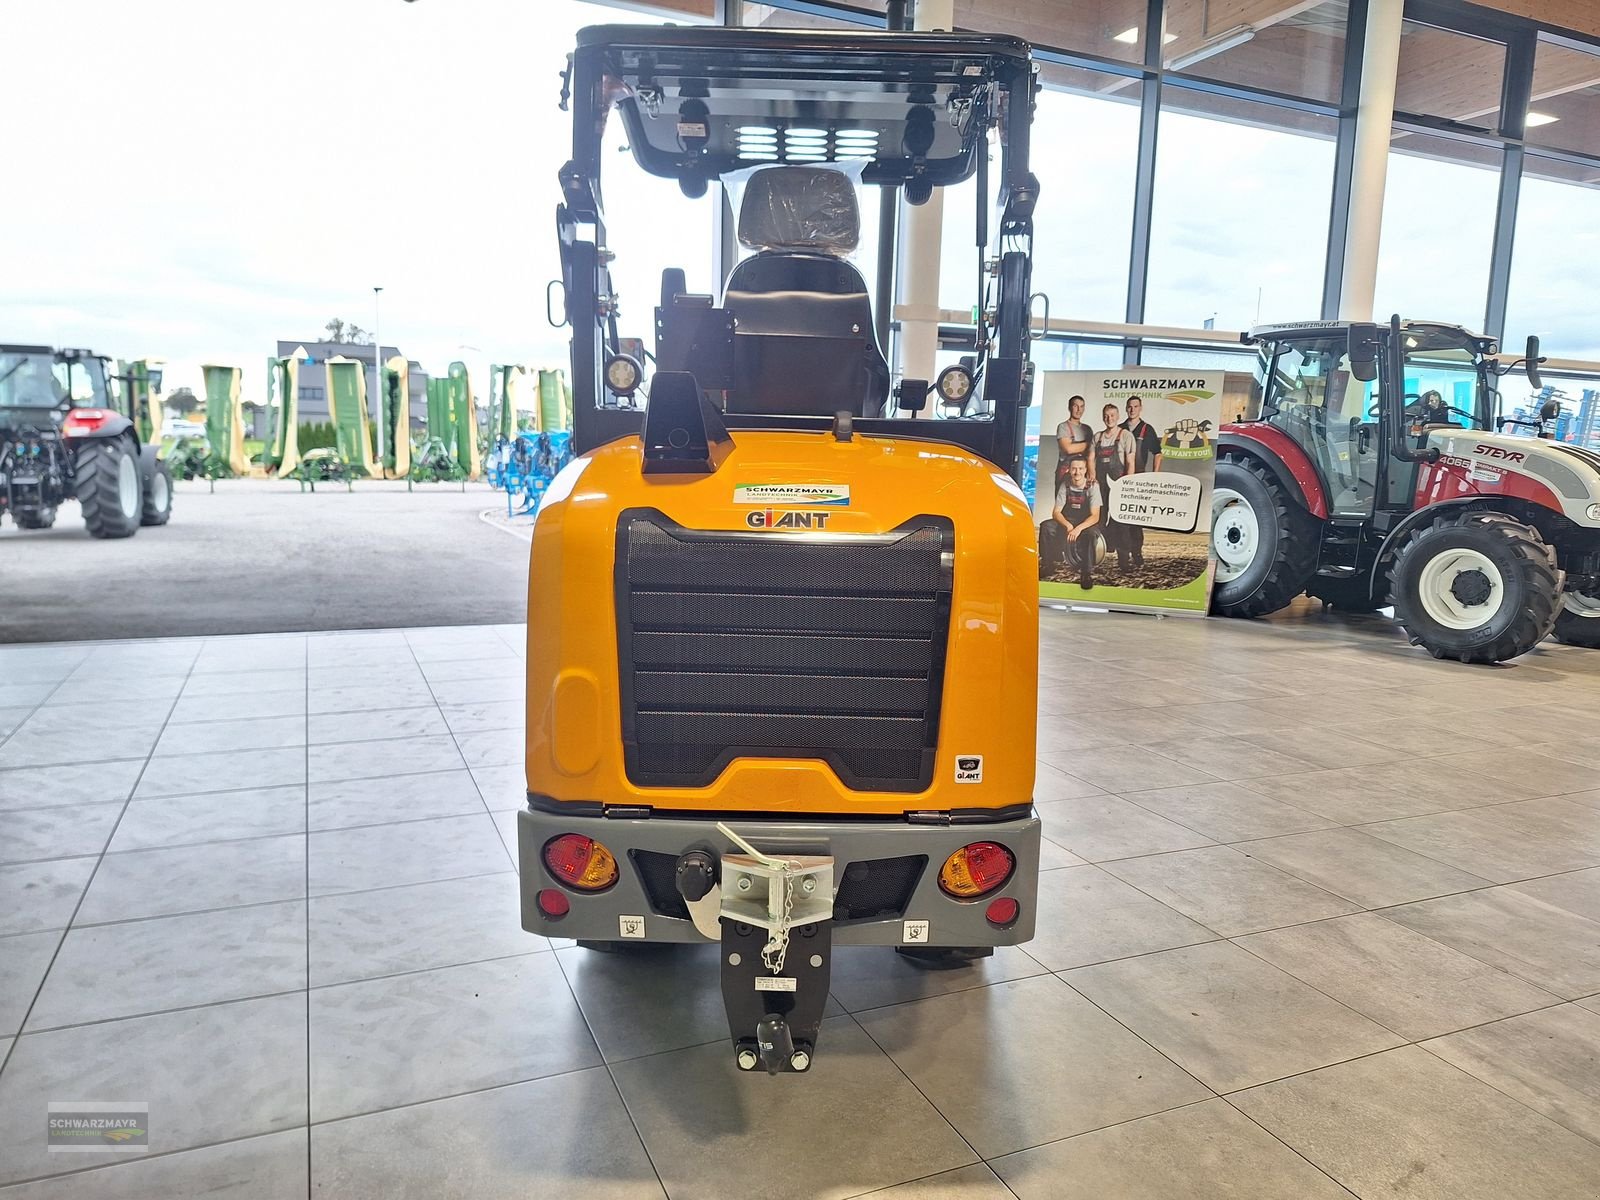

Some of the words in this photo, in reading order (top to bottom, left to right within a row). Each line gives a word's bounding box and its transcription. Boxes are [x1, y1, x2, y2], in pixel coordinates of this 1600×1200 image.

[1103, 379, 1206, 390] SCHWARZMAYR
[1103, 391, 1163, 399] LANDTECHNIK
[1171, 449, 1193, 457] WANT
[1473, 444, 1525, 463] STEYR
[1440, 456, 1470, 469] 4065
[1160, 482, 1191, 491] Lehrlinge
[1136, 487, 1191, 497] Landmaschinen-
[1120, 503, 1147, 514] DEIN
[1150, 505, 1175, 516] TYP
[1118, 513, 1153, 522] GEFRAGT!
